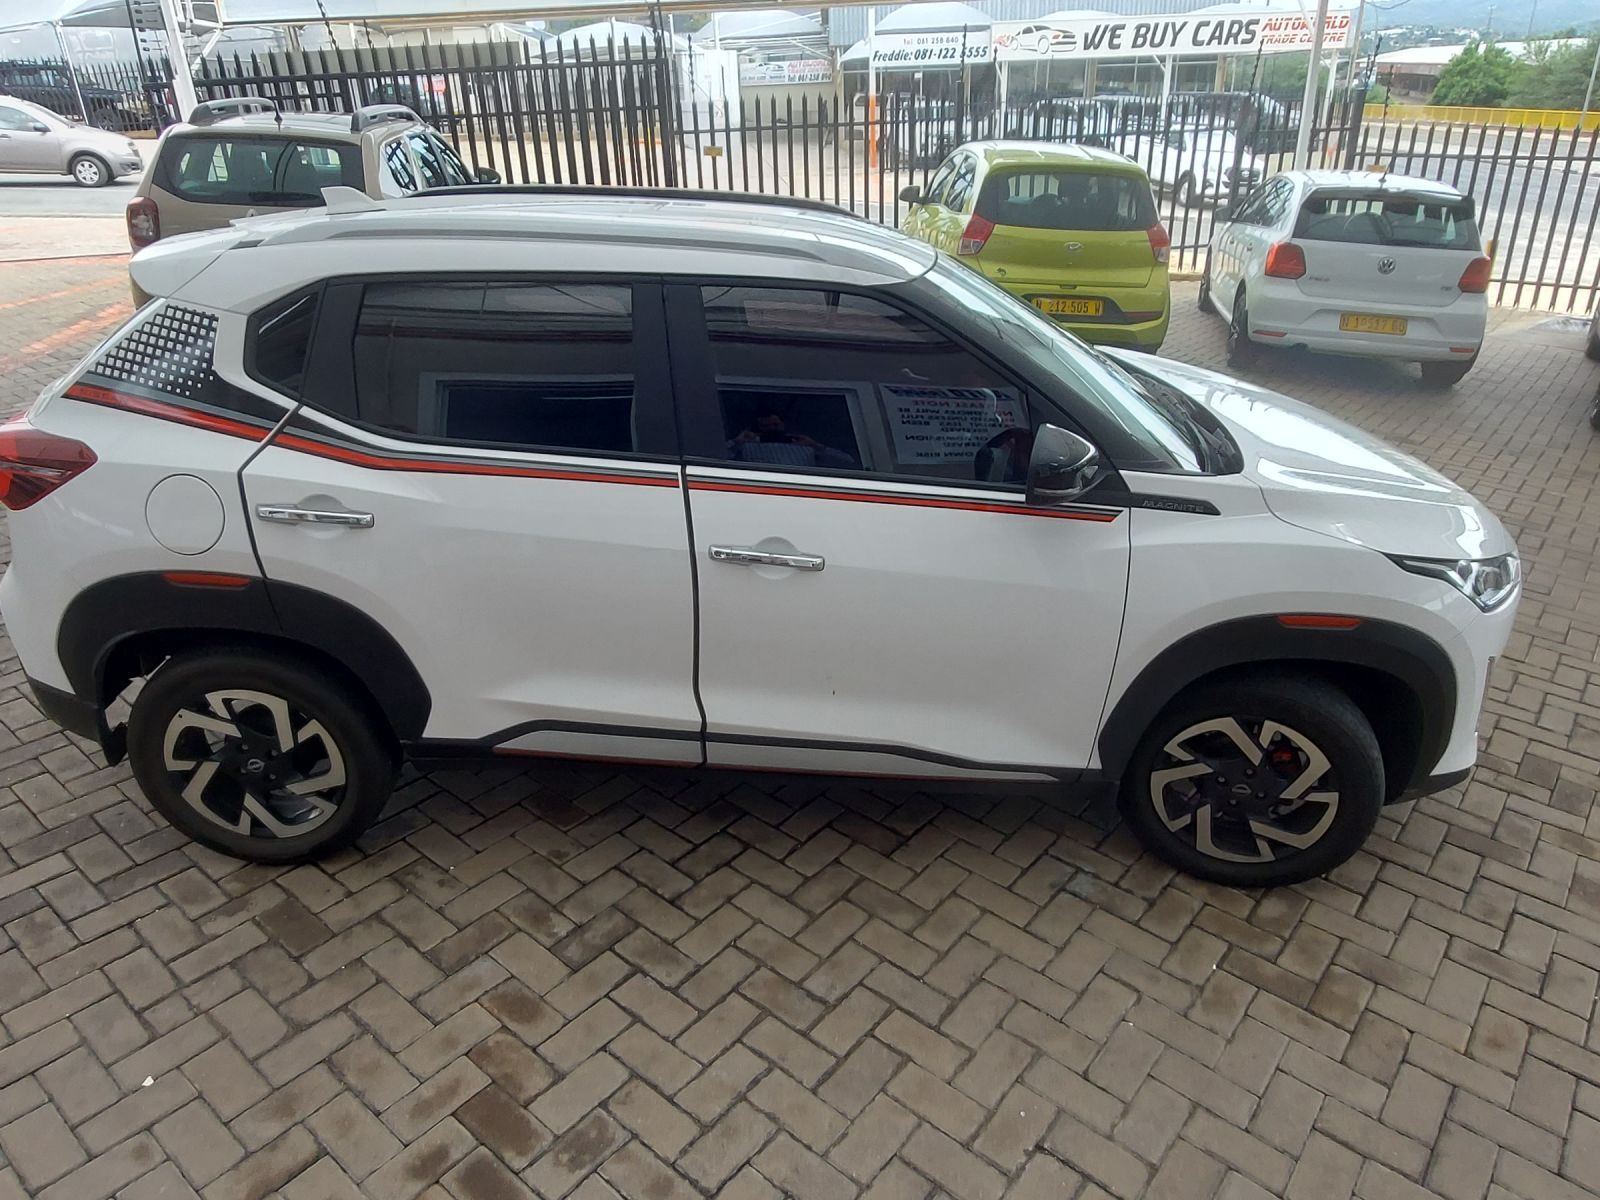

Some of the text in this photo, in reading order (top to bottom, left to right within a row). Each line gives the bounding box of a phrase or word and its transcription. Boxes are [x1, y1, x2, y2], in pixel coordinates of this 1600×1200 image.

[1083, 18, 1260, 50] WE BUY CARS
[1262, 33, 1298, 44] TRADE
[873, 49, 913, 62] Freddie:
[914, 47, 957, 60] 081-122
[1142, 500, 1204, 512] MAGNITE
